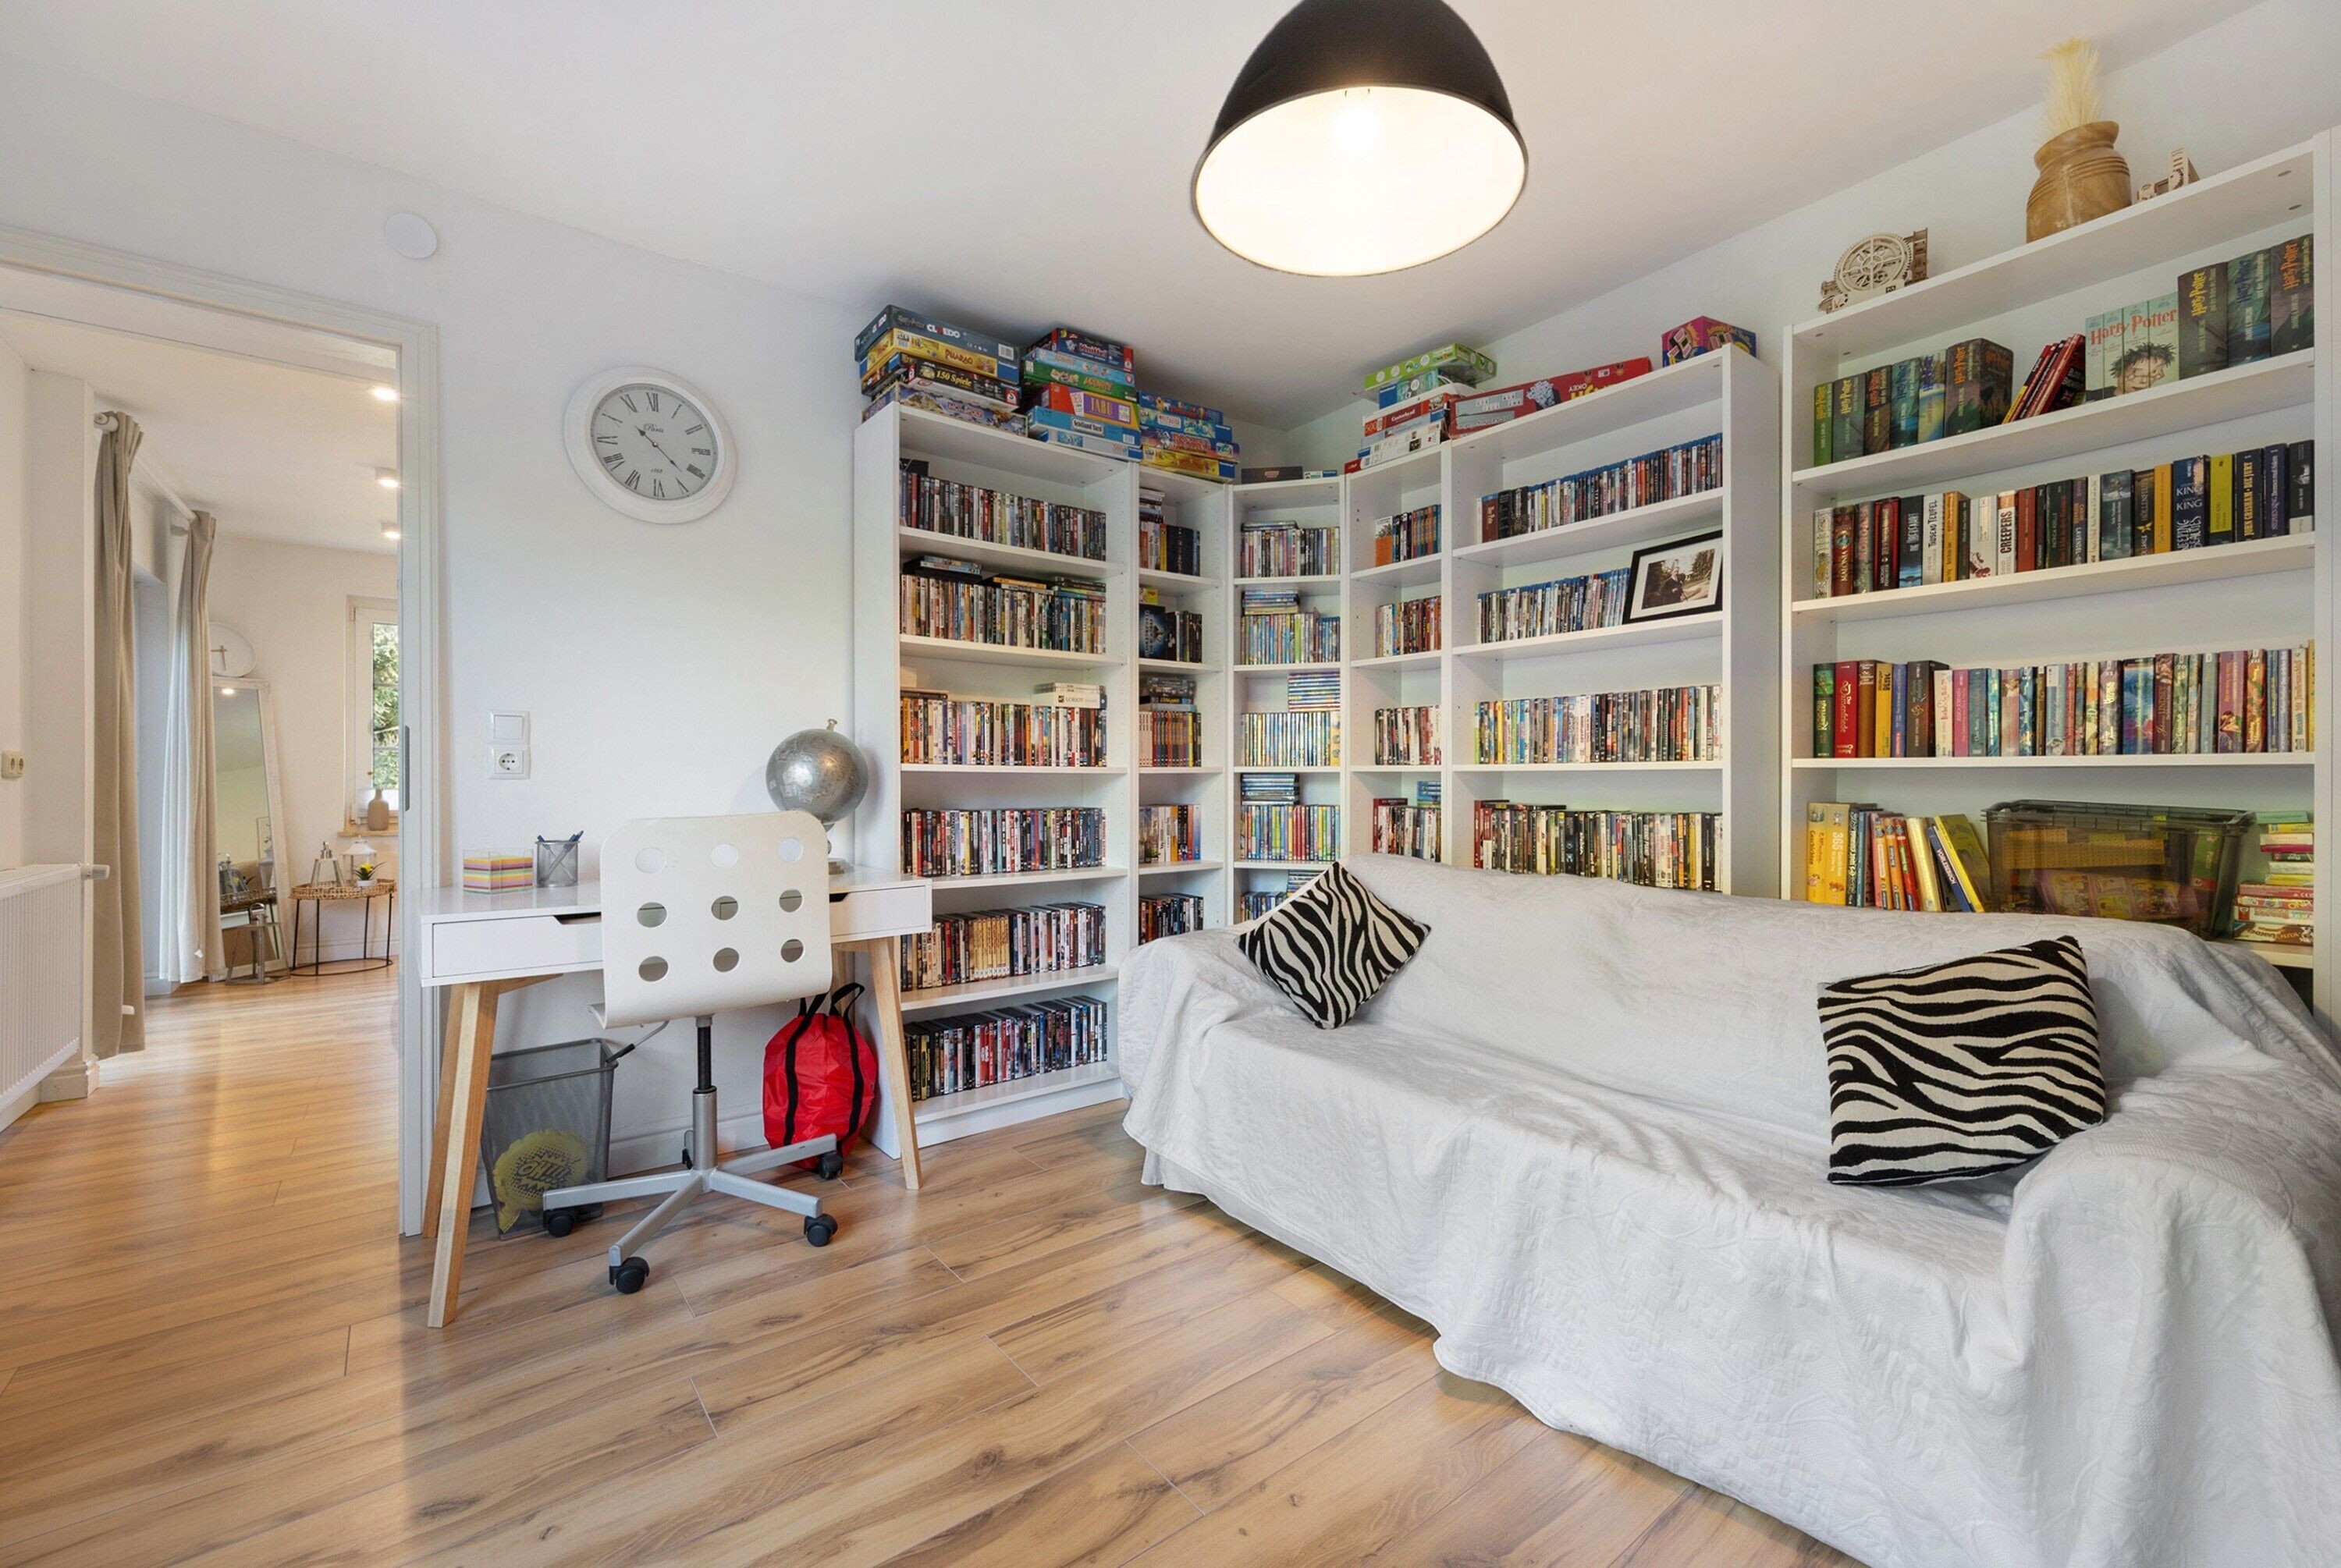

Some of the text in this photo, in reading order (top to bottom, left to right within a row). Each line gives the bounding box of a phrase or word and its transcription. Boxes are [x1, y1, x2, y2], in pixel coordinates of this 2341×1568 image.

[2280, 243, 2299, 289] Harry Potter
[2189, 271, 2208, 316] Harry Potter
[2090, 308, 2177, 345] Harry Potter
[936, 371, 972, 387] 150 Spiele
[1568, 382, 1588, 392] OKEY
[1090, 398, 1113, 416] TABU
[2244, 462, 2254, 476] JURY
[2176, 485, 2203, 497] KING
[2176, 498, 2203, 511] KING
[2244, 491, 2253, 520] GRISHAM
[1927, 500, 1938, 547] TAUSEND TEUFEL
[2000, 511, 2012, 553] CREEPERS
[2244, 520, 2254, 535] JOHN
[1832, 832, 1843, 850] 365
[1937, 849, 1956, 885] VORLESEBUCH
